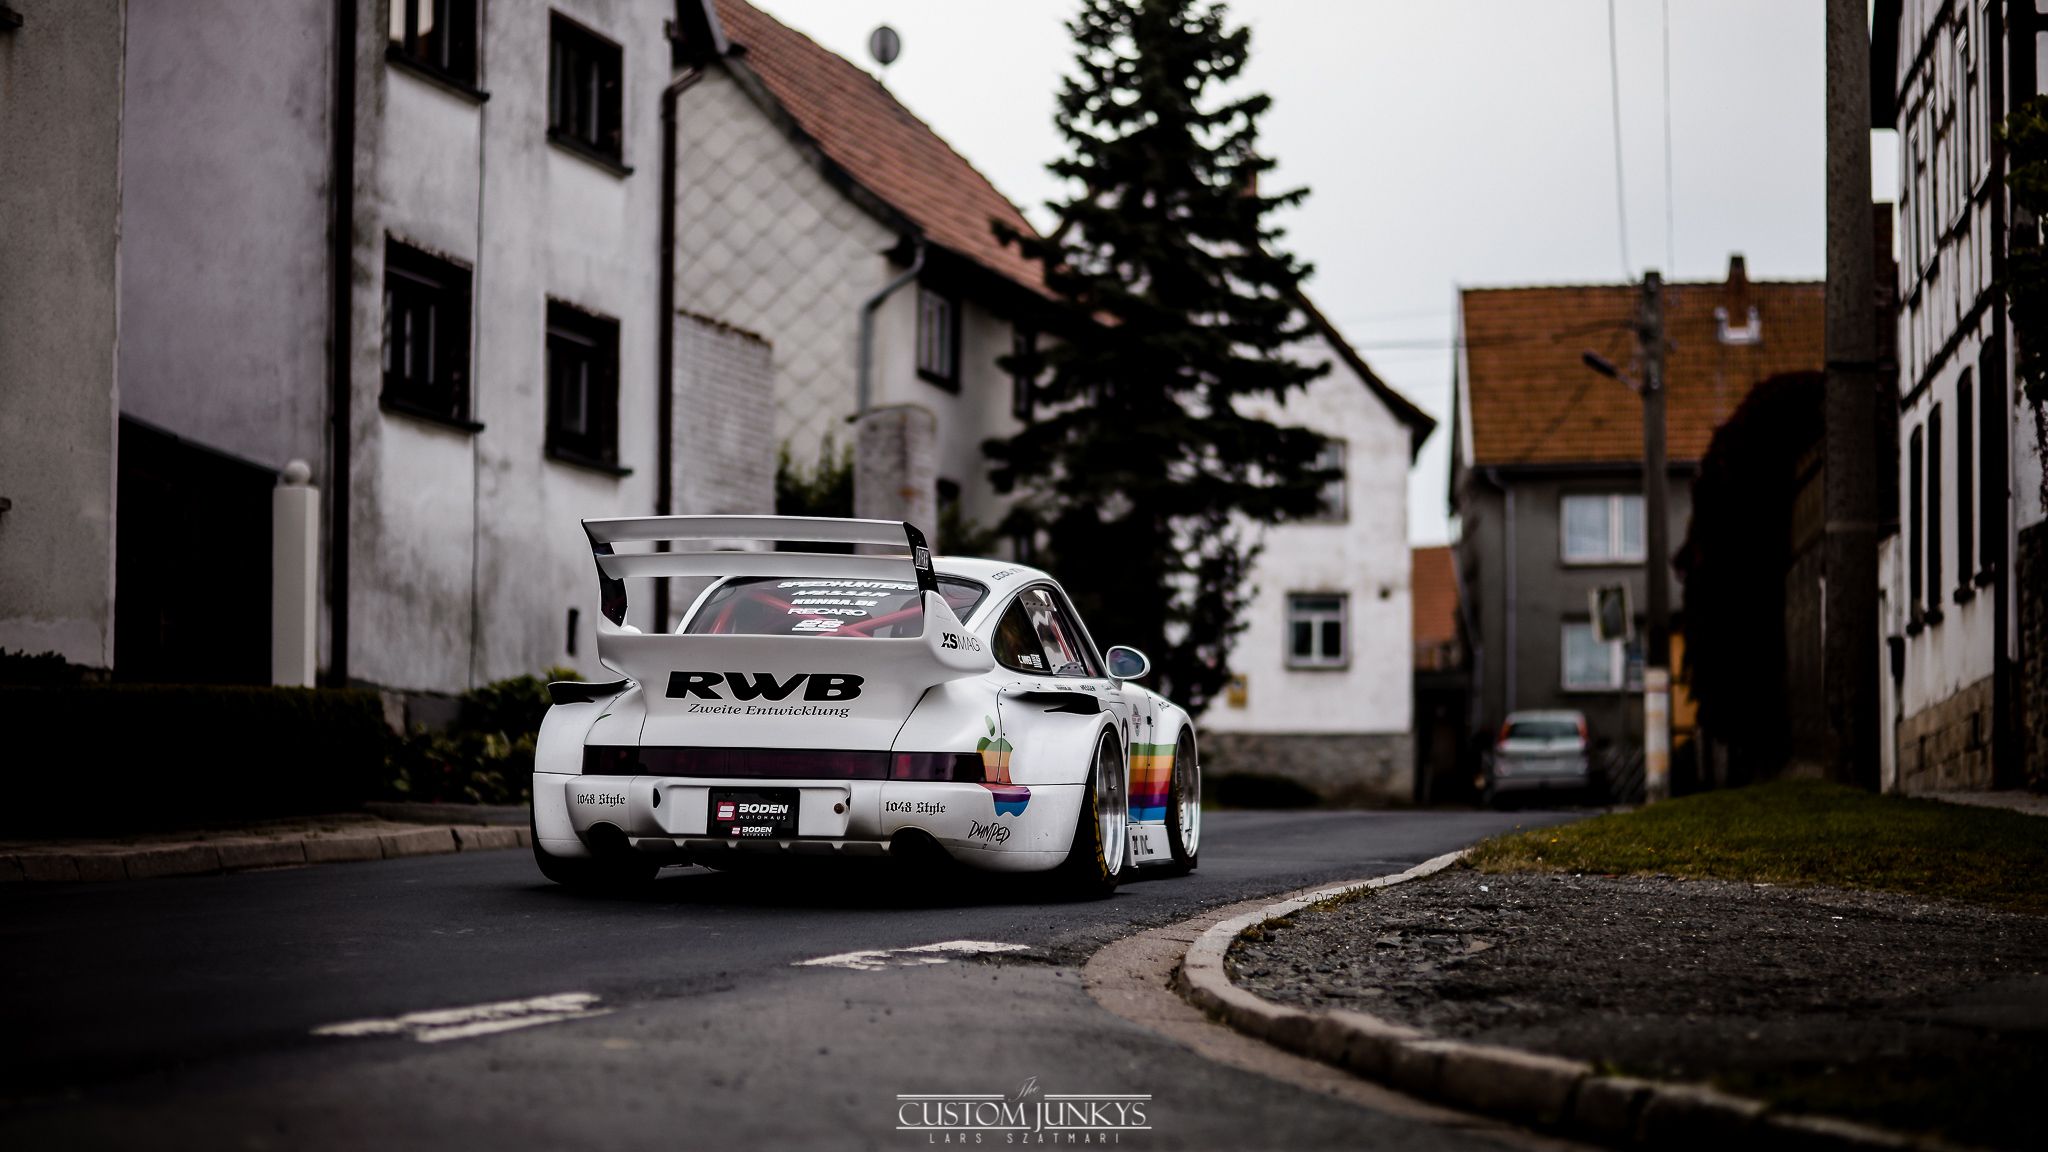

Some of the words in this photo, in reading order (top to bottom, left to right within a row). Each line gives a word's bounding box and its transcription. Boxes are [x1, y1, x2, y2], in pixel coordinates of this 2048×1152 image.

[777, 580, 918, 591] SPEEDHUNTERS
[787, 607, 868, 617] RECARO
[665, 671, 866, 702] RWB
[688, 703, 742, 714] Zweite
[745, 704, 850, 718] Entwicklung
[577, 793, 596, 805] 1048
[598, 793, 626, 807] Style
[738, 803, 789, 814] BODEN
[885, 801, 912, 814] 1048
[916, 801, 946, 816] Style
